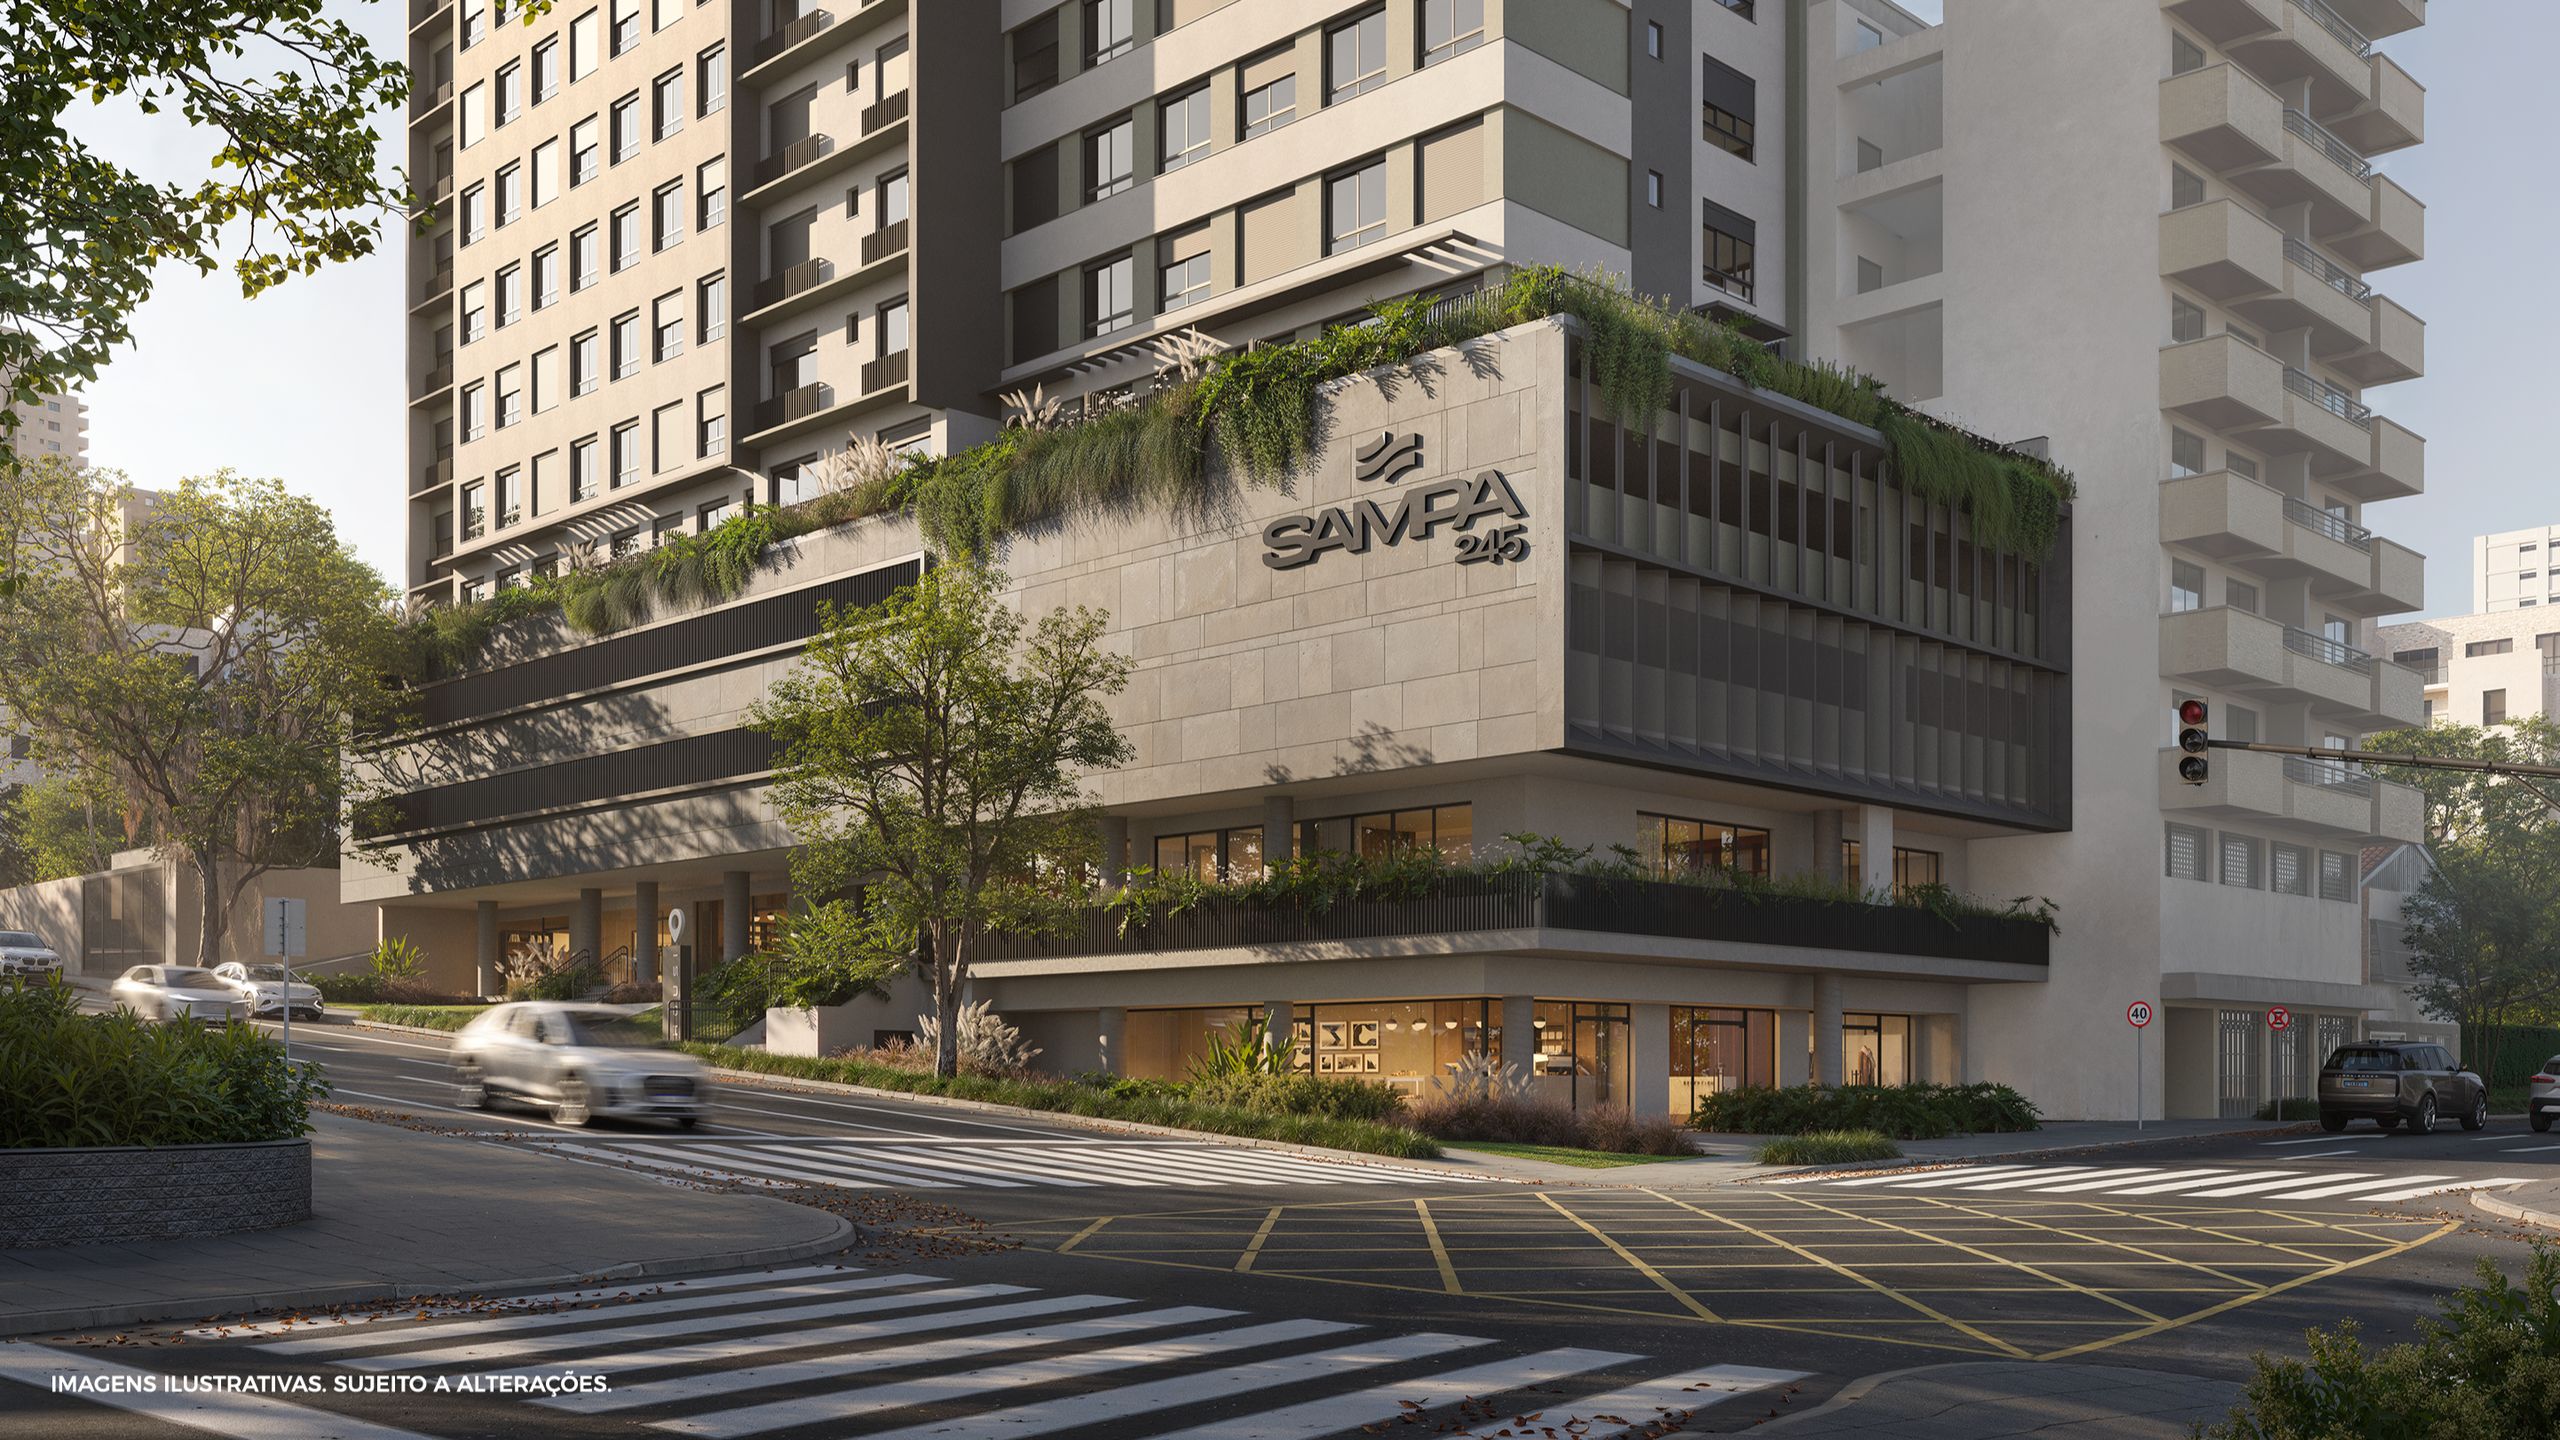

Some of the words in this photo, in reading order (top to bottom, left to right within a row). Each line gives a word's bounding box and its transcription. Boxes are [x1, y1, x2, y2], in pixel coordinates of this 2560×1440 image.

[1262, 469, 1530, 570] SAMPA
[1455, 523, 1531, 566] 245
[2131, 1007, 2148, 1020] 40
